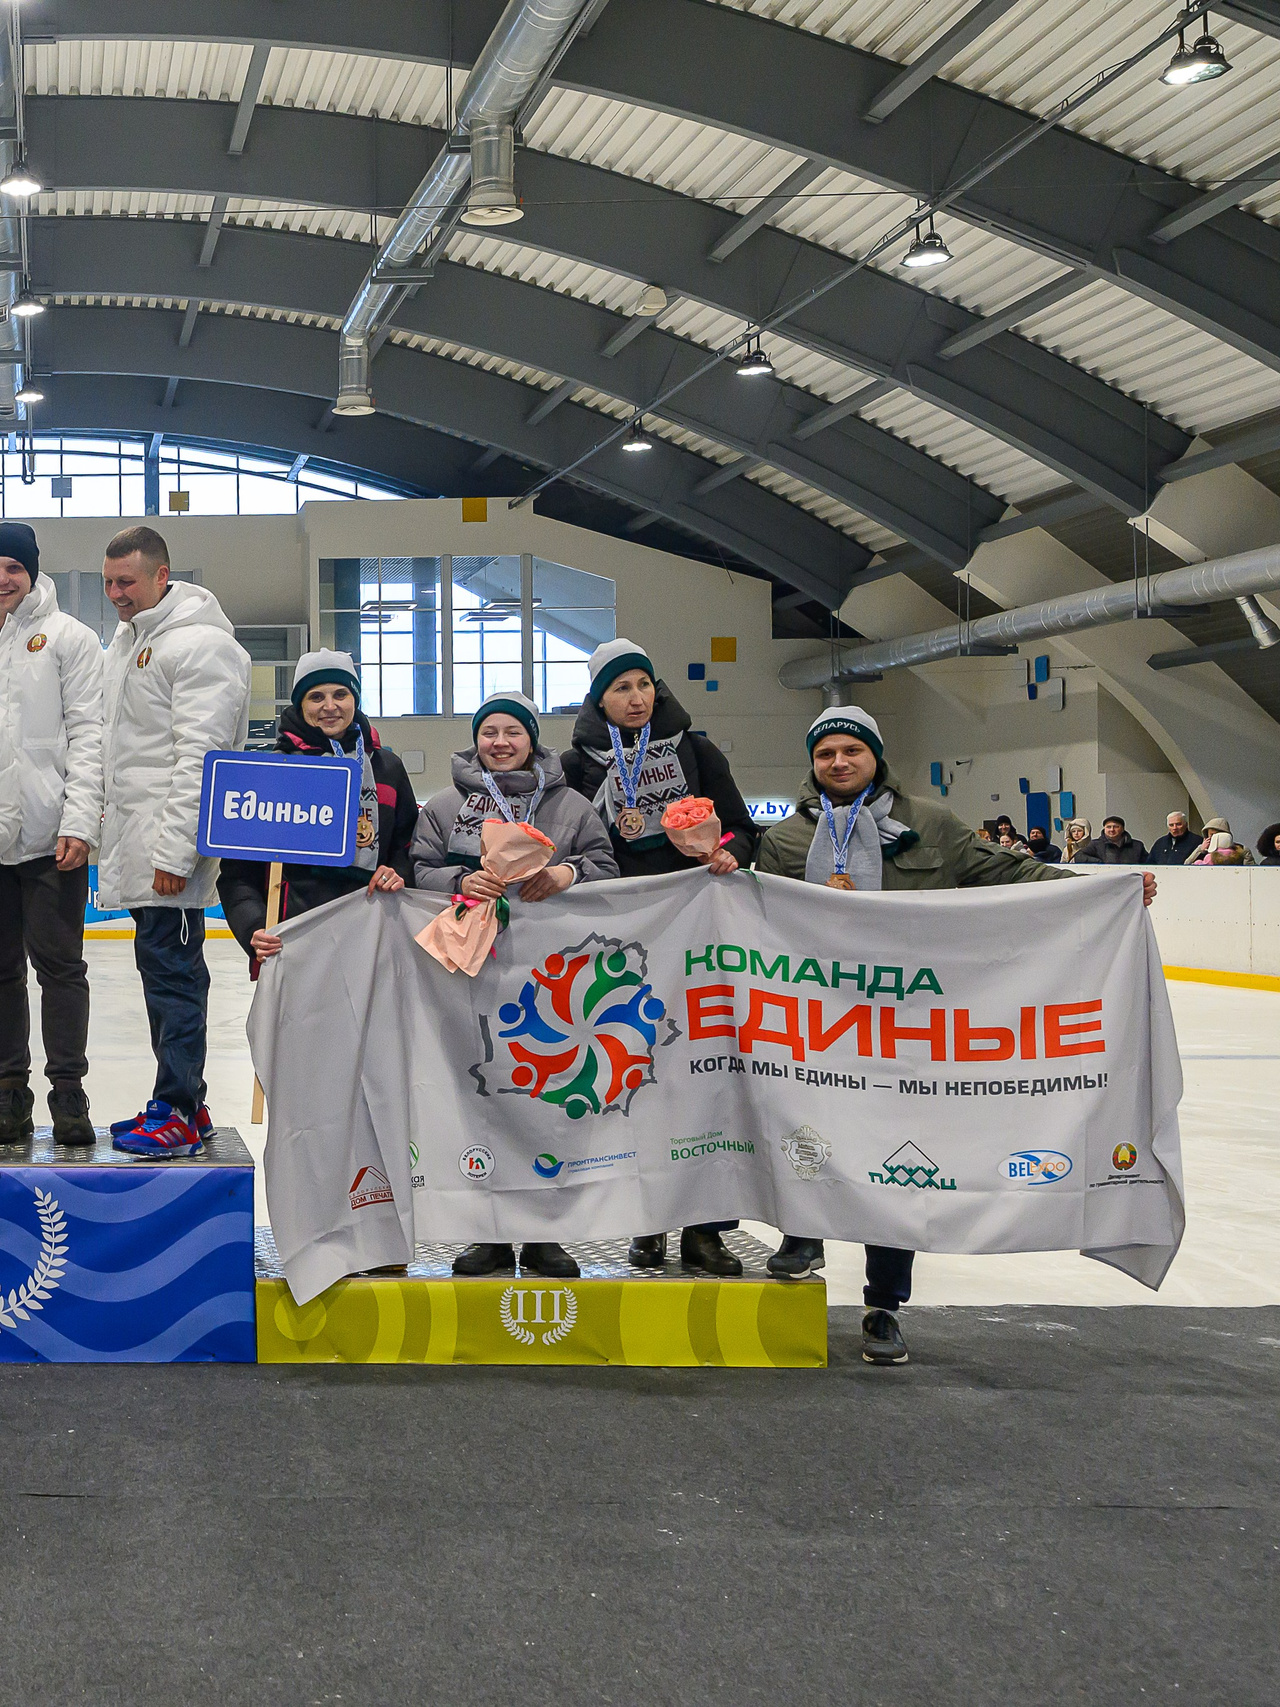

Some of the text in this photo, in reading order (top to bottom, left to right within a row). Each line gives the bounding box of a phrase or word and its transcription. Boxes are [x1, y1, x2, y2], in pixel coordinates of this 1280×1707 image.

[614, 763, 678, 792] ЕИНЫЕ
[223, 790, 334, 826] Единые
[685, 943, 944, 1001] КОМАНДА
[685, 984, 1106, 1063] ЕДИНЫЕ
[689, 1055, 747, 1075] КОГДА
[751, 1060, 789, 1079] МЫ
[794, 1067, 867, 1091] ЕДИНЫ
[899, 1079, 937, 1096] МЫ
[945, 1072, 1109, 1096] НЕПОБЕДИМЫ!
[567, 1151, 637, 1168] ПРОМТРАНСИНВЕСТ
[671, 1139, 755, 1161] ВОСТОЧНЫЙ
[513, 1290, 565, 1323] III
